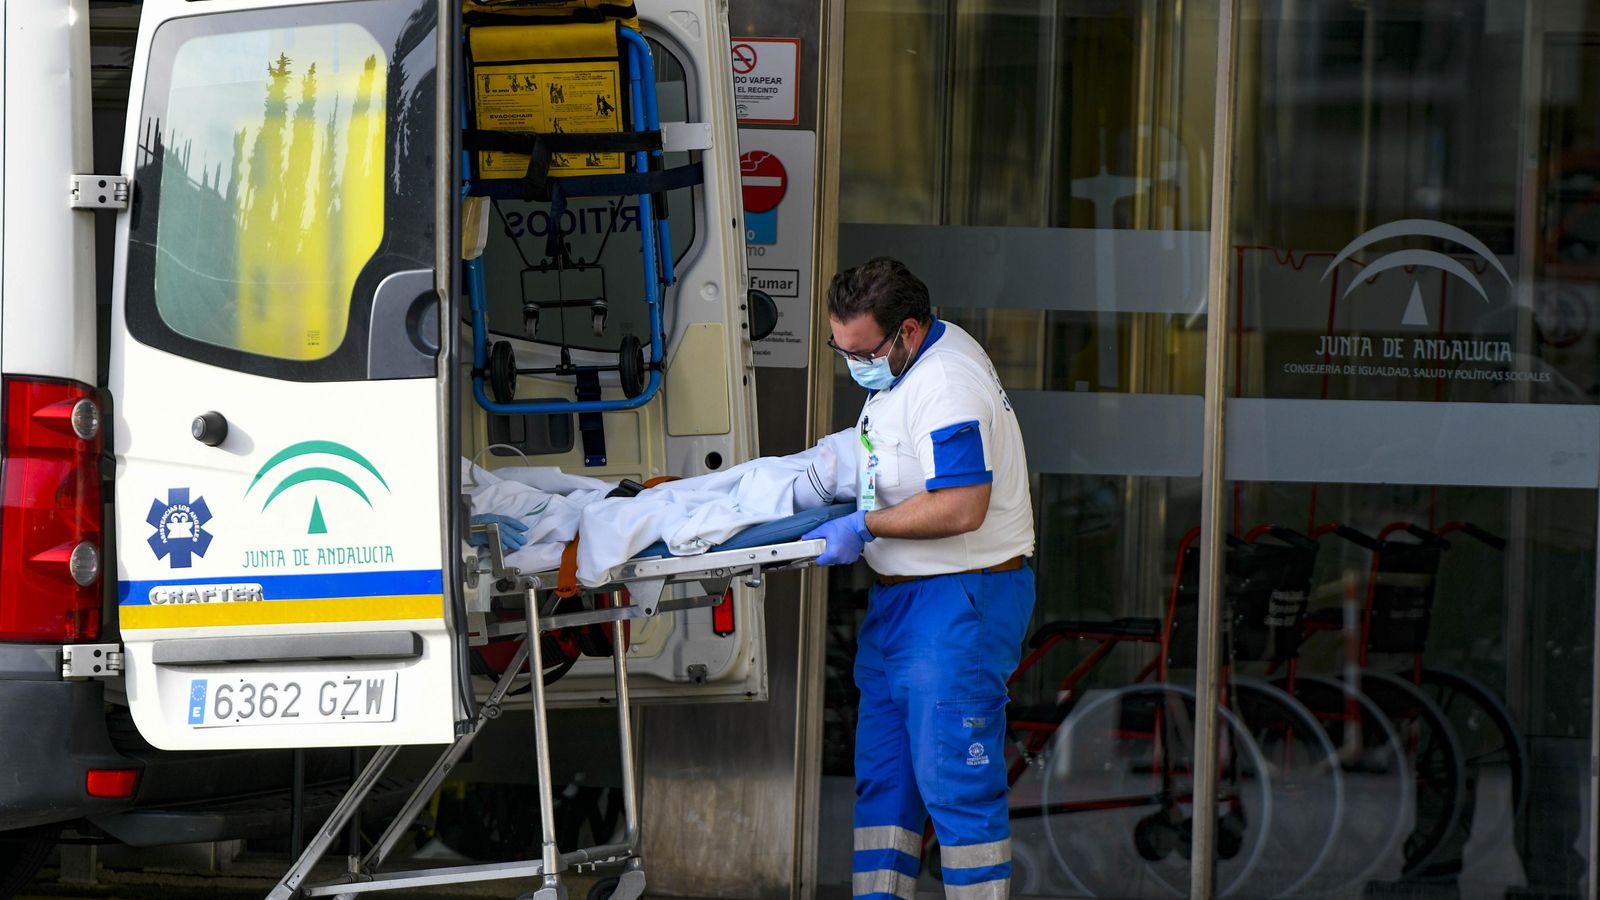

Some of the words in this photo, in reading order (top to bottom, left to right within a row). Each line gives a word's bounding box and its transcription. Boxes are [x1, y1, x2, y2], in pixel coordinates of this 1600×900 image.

[735, 76, 747, 84] DO
[749, 76, 782, 85] VAPEAR
[748, 86, 779, 94] RECINTO
[750, 276, 794, 289] Fumar
[1315, 335, 1373, 357] JUNTA
[1382, 337, 1404, 359] DE
[1283, 363, 1341, 375] CONSEJERÍA
[1343, 365, 1358, 375] DE
[1358, 365, 1411, 378] IGUALDAD,
[1454, 368, 1504, 381] POLÍTICAS
[1505, 371, 1551, 382] SOCIALES
[178, 504, 191, 513] LOS
[242, 550, 286, 568] JUNTA
[294, 549, 310, 566] DE
[317, 545, 394, 566] ANDALUCIA
[150, 585, 263, 605] CRAFTER
[192, 706, 201, 718] E
[213, 681, 302, 720] 6362
[318, 678, 385, 716] GZW
